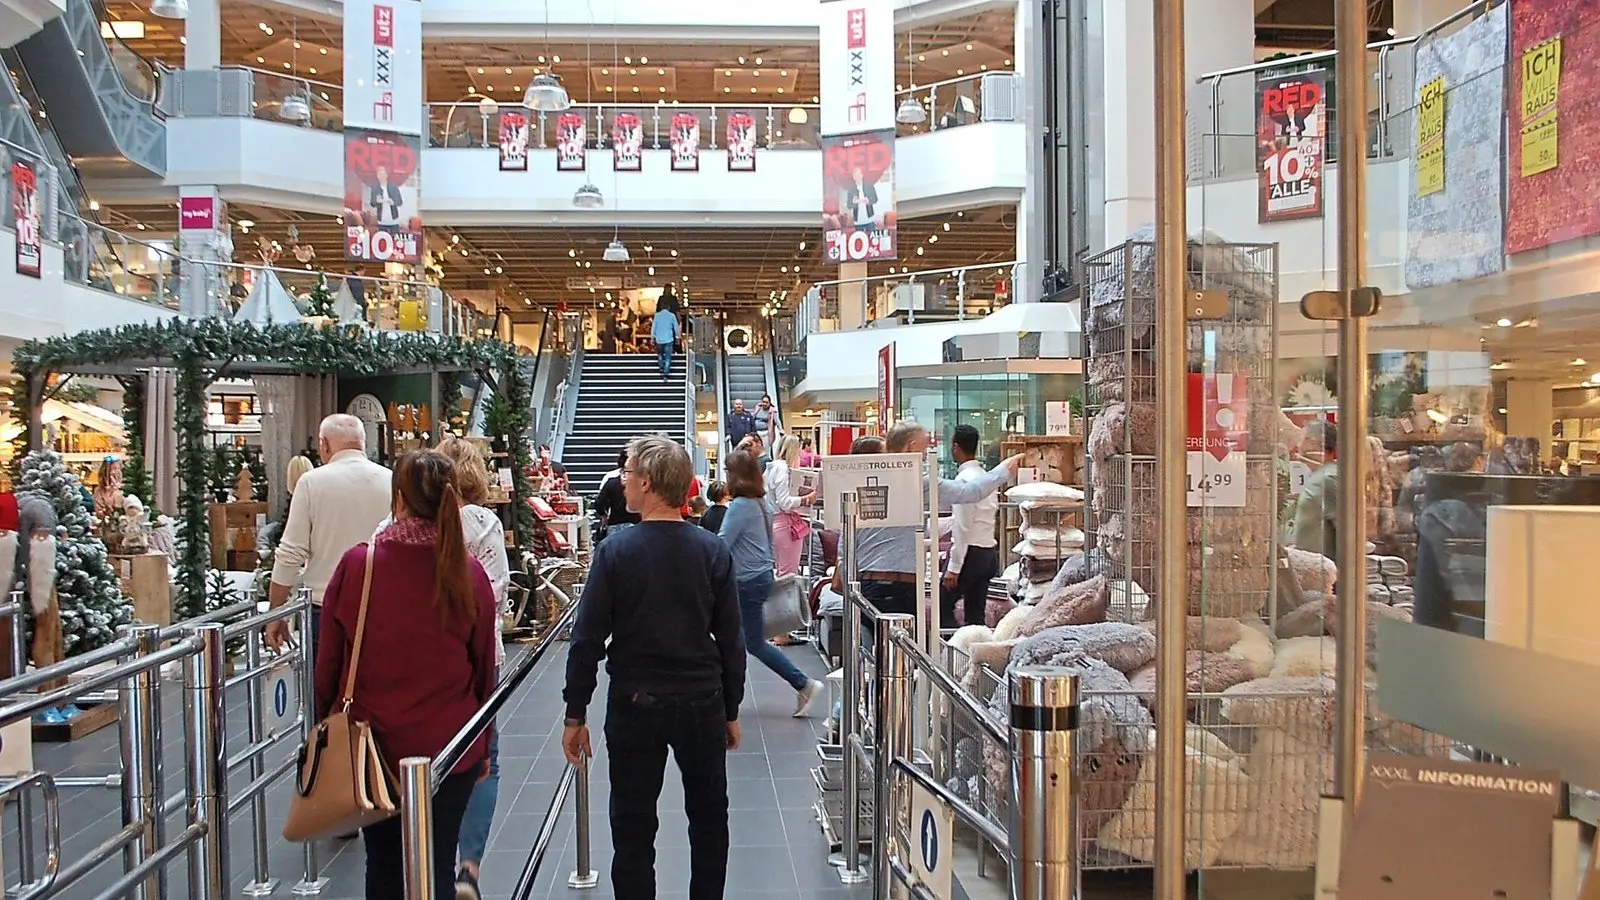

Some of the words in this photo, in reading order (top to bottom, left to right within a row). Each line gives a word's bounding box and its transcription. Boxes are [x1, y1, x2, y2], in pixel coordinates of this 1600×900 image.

[1526, 44, 1556, 80] ICH
[1263, 84, 1321, 114] RED
[1420, 83, 1441, 113] ICH
[1525, 72, 1552, 98] WILL
[1526, 87, 1556, 115] RAUS
[1420, 119, 1441, 143] RAUS
[347, 141, 416, 174] RED
[826, 143, 892, 176] RED
[11, 163, 36, 188] RED
[1271, 178, 1311, 199] ALLE
[1369, 765, 1411, 781] XXXL
[1417, 769, 1553, 795] INFORMATION
